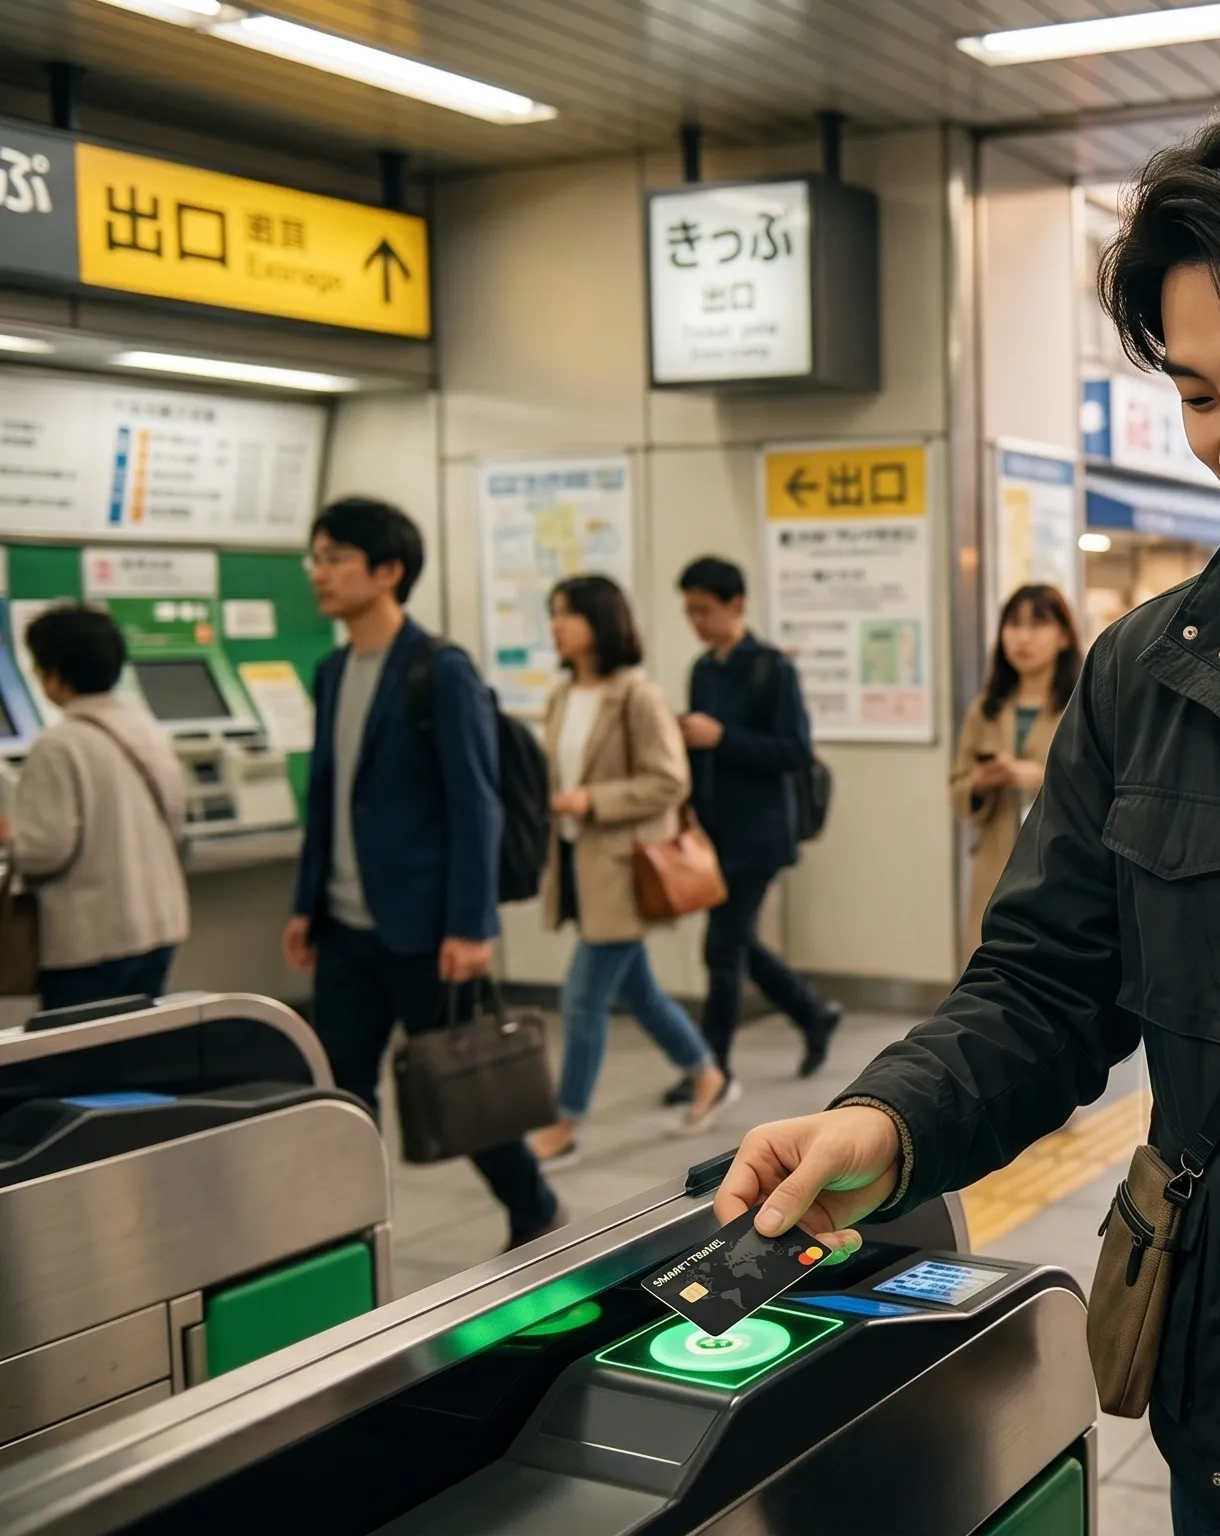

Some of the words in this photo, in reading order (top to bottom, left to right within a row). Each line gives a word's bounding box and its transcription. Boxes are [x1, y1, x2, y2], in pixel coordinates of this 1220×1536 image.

[105, 183, 229, 267] 出口
[702, 280, 754, 313] 出口
[826, 461, 907, 508] 出口
